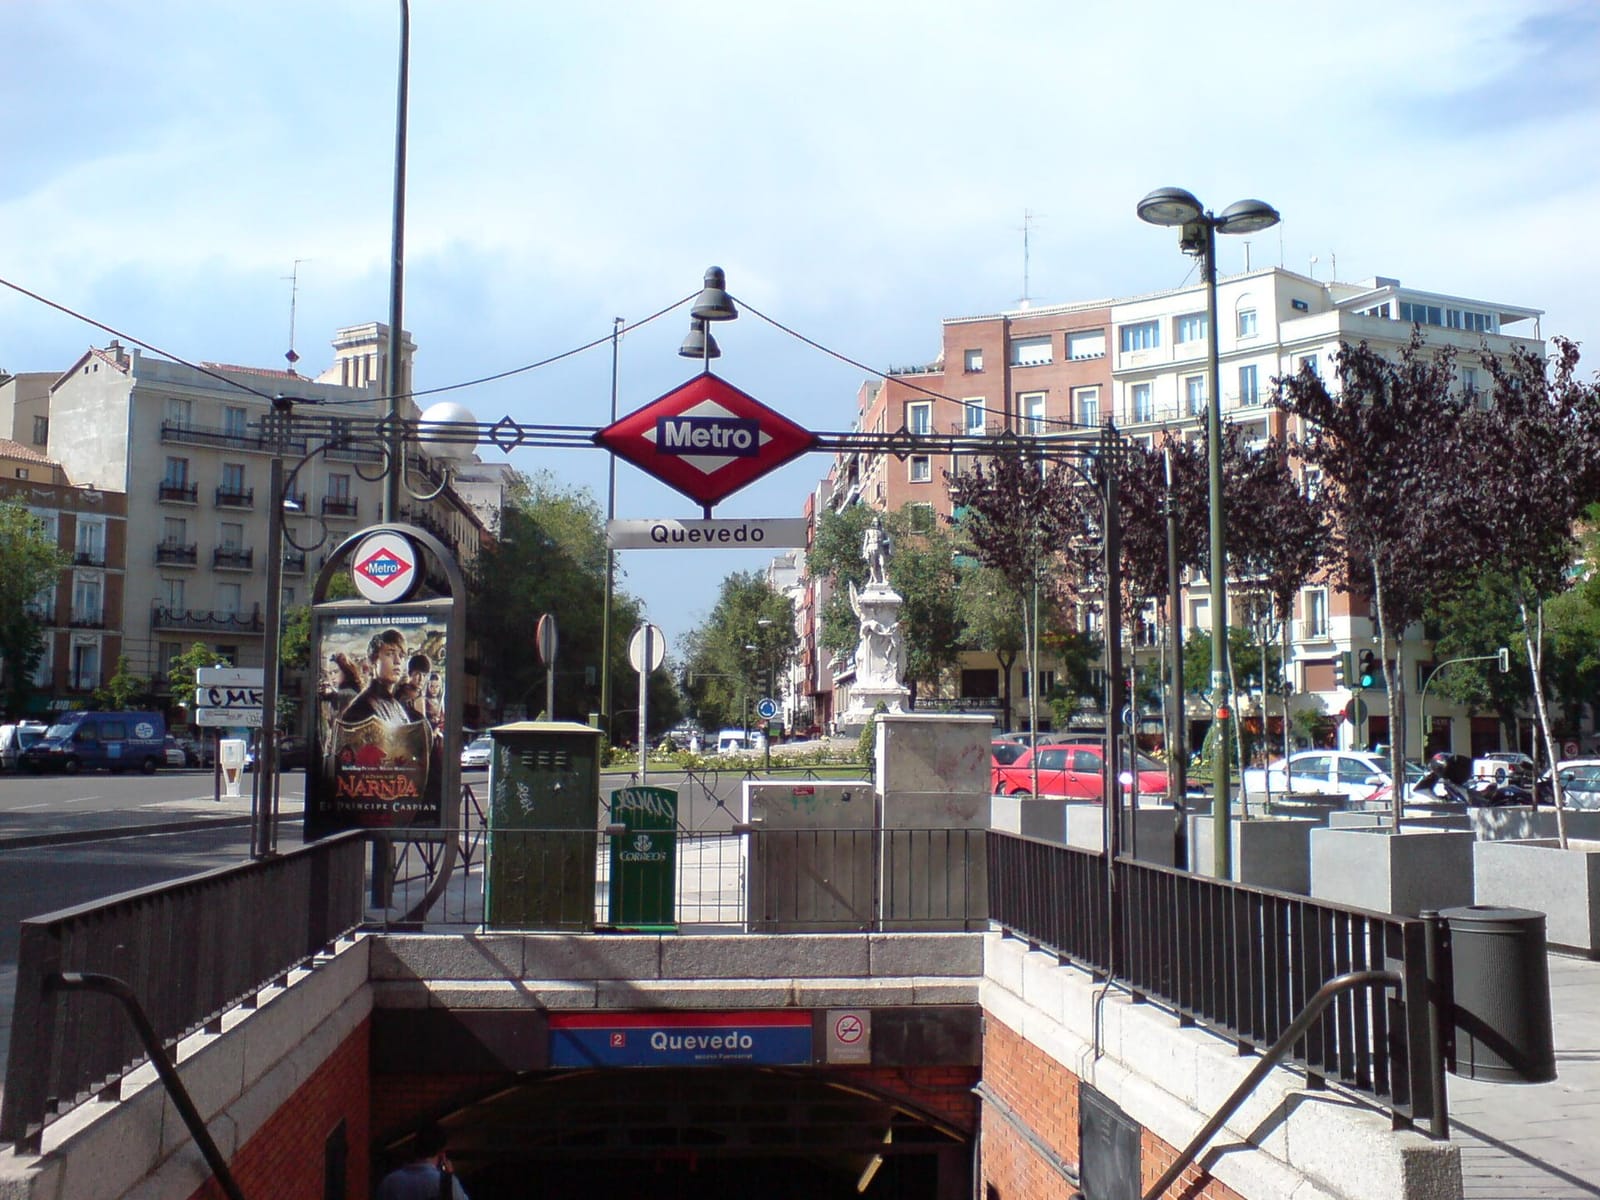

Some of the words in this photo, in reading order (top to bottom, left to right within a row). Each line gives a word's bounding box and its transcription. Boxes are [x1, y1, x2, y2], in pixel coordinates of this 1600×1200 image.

[664, 420, 752, 449] Metro
[651, 524, 765, 543] Quevedo
[368, 562, 398, 575] Metro
[336, 774, 419, 800] NARNIA
[392, 802, 437, 812] CASPIAN
[614, 1034, 622, 1045] 2
[650, 1031, 753, 1050] Quevedo
